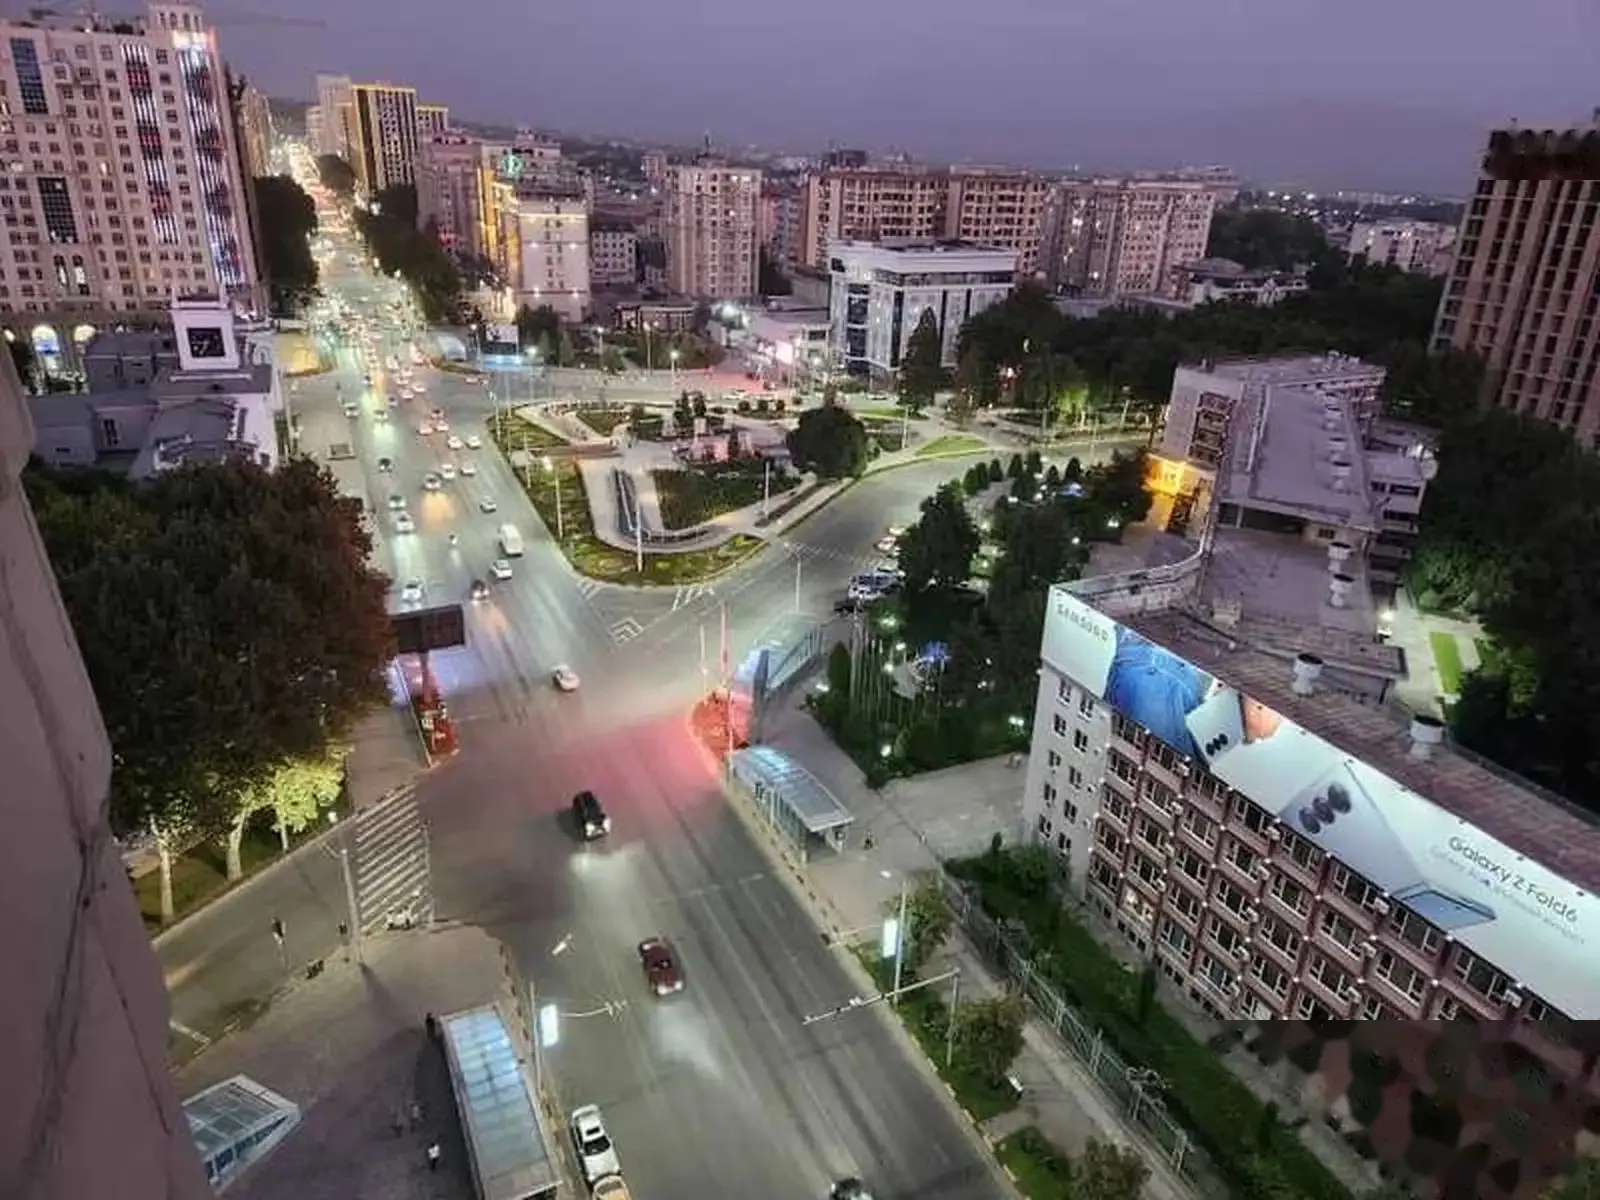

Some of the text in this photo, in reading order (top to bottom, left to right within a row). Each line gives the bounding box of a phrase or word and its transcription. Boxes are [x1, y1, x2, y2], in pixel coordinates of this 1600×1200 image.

[1449, 836, 1578, 923] Galaxy Z Fold6
